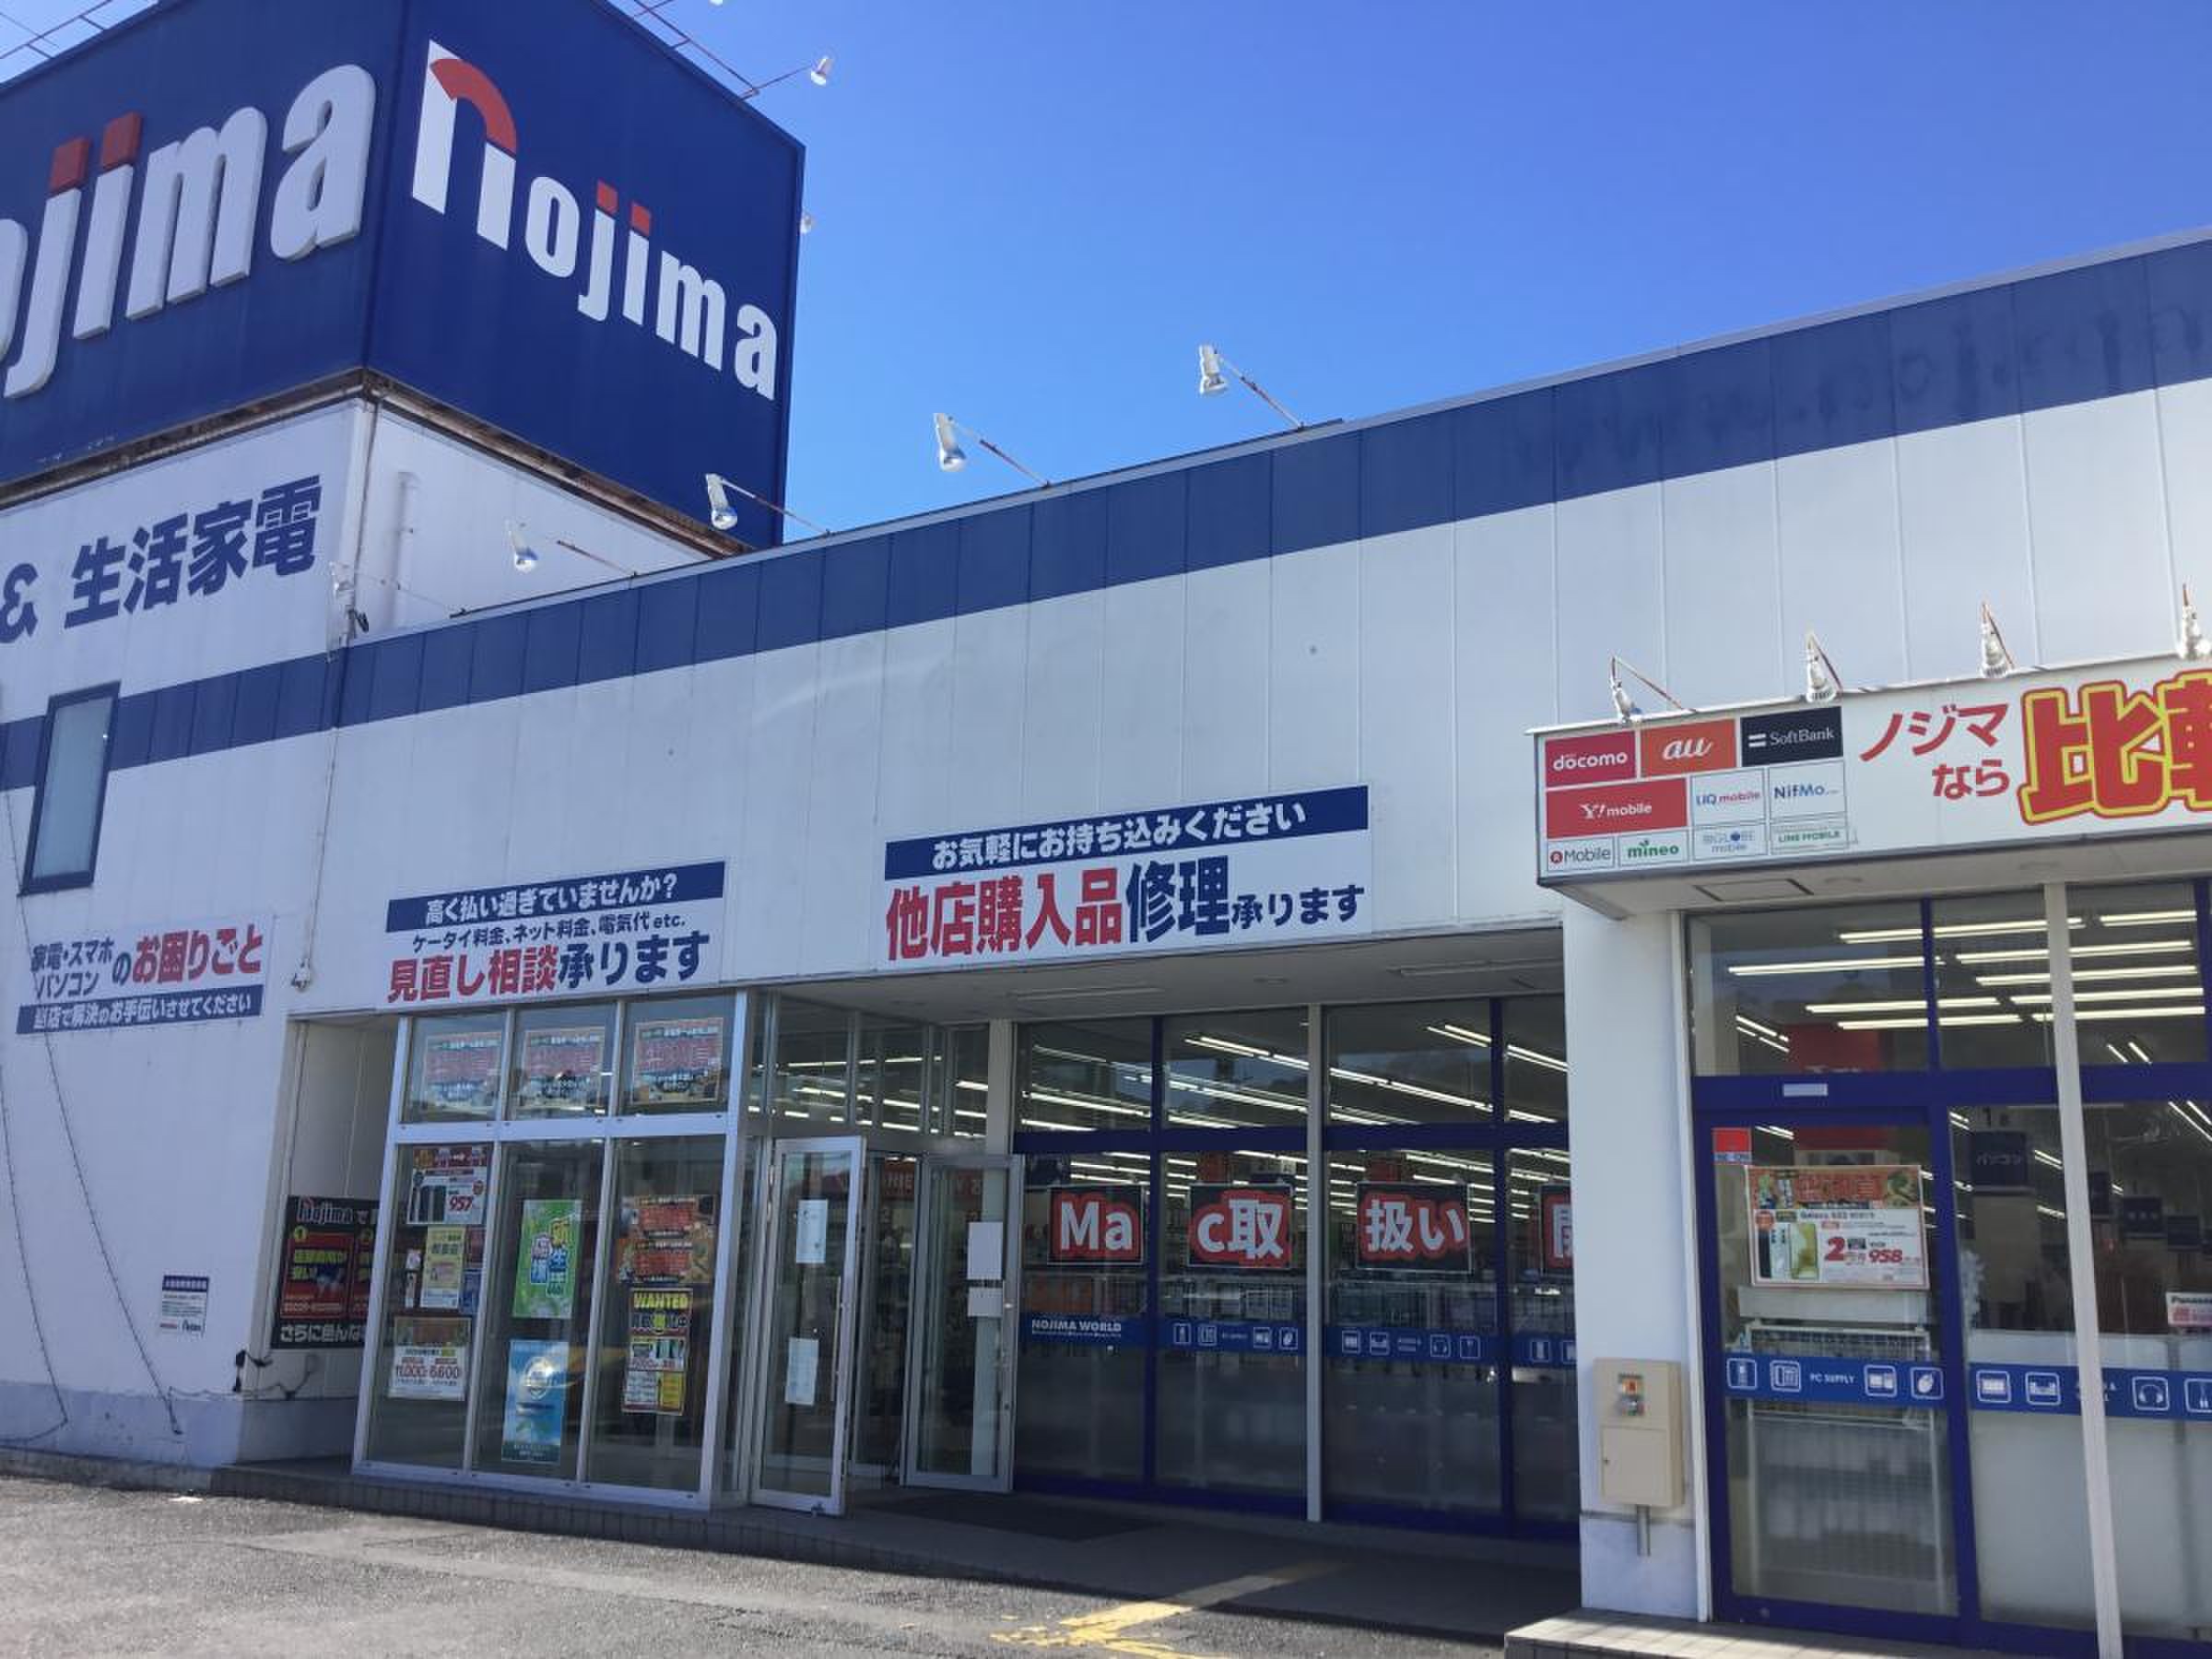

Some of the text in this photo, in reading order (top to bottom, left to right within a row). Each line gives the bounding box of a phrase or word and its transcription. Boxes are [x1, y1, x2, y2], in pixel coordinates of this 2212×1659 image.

[412, 40, 777, 401] nojima
[64, 475, 323, 629] 生活家電
[1769, 726, 1835, 746] SoftBank
[1859, 703, 2009, 762] ノジマ
[1553, 750, 1629, 771] docomo
[1662, 736, 1713, 760] au
[1932, 759, 2010, 800] なら
[1696, 790, 1761, 806] UQ mobile
[932, 801, 1306, 871] お気軽にお持ち込みください
[1628, 840, 1679, 859] mineo
[1564, 846, 1611, 863] Mobile
[387, 930, 711, 1003] 見直し相談承ります
[36, 971, 100, 1000] パソコン
[1061, 1201, 1133, 1252] Ma
[1198, 1199, 1284, 1259] c取
[1366, 1200, 1465, 1253] 扱い
[1824, 1236, 1846, 1262] 2
[634, 1292, 689, 1309] WANTED
[1031, 1319, 1122, 1333] NOJIMA WORLD
